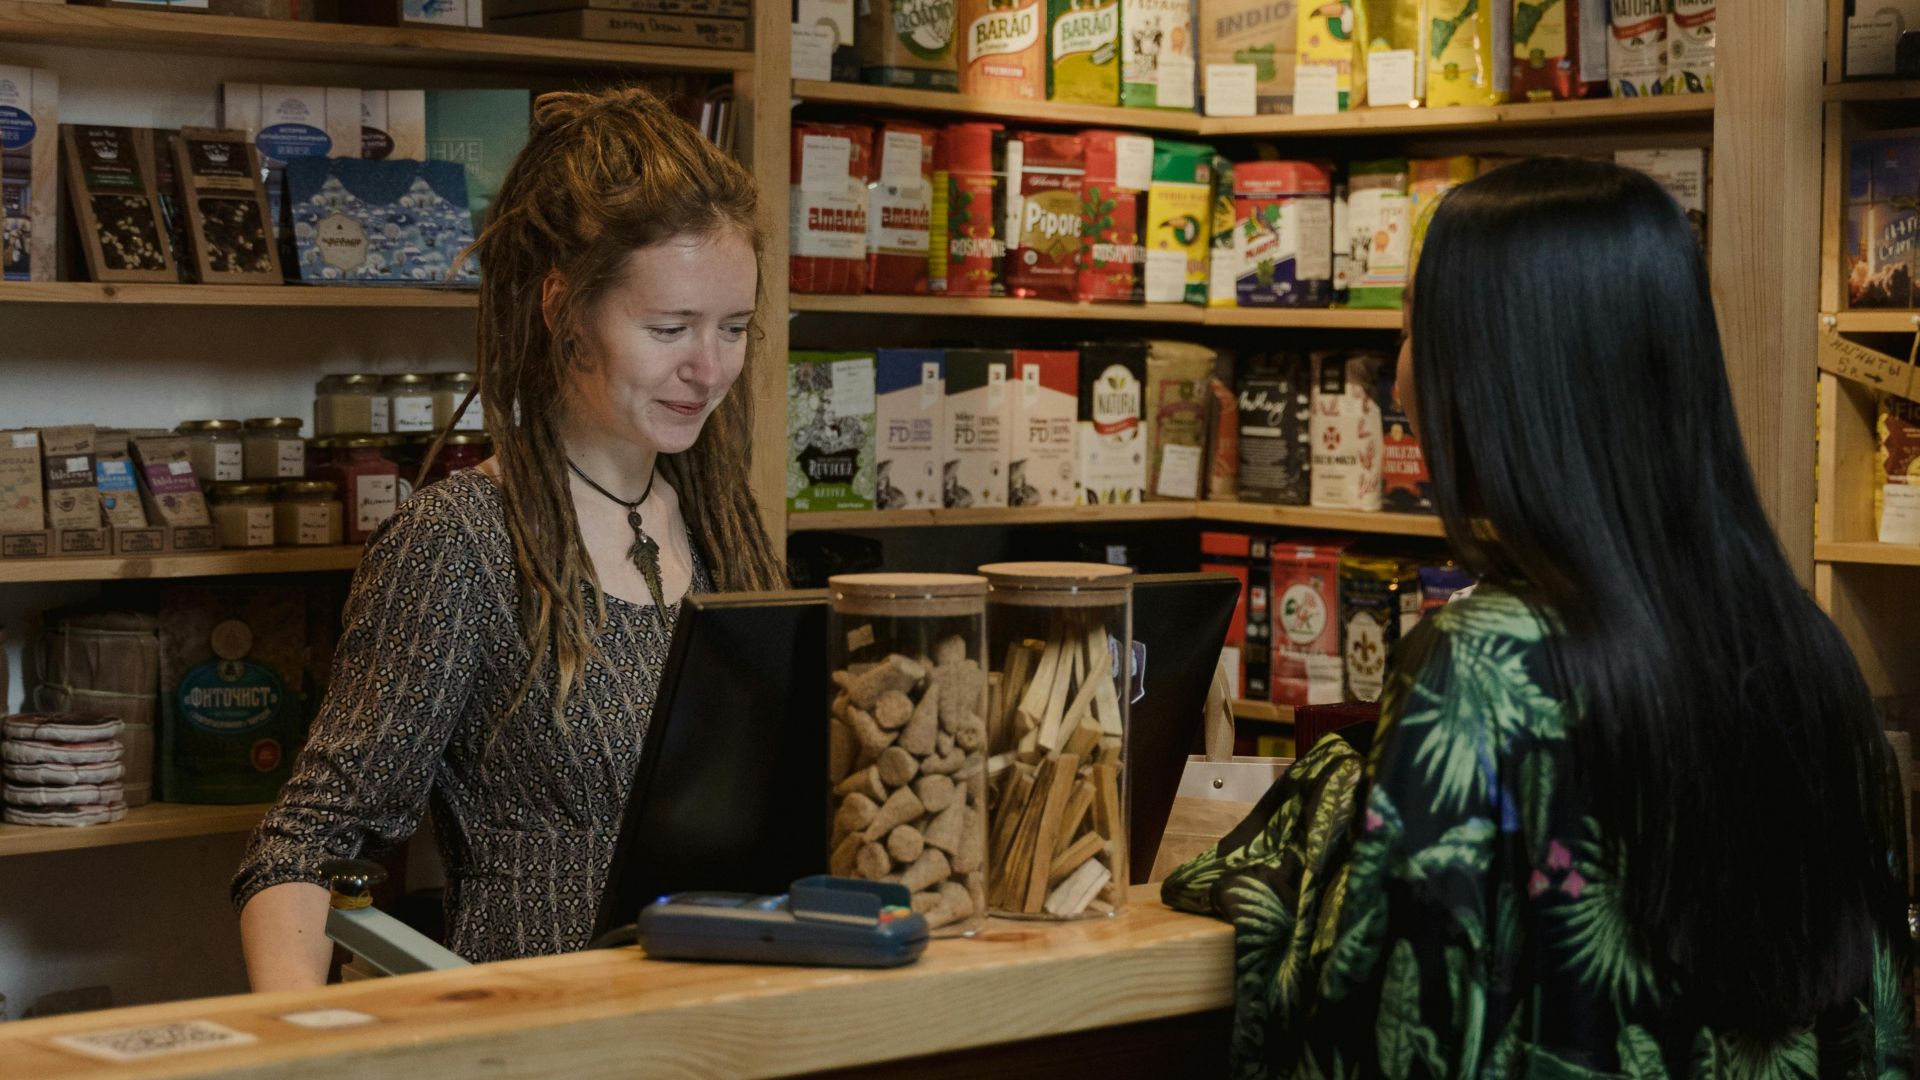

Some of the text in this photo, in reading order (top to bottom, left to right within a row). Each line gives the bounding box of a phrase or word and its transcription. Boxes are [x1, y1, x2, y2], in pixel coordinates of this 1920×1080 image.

[976, 13, 1032, 43] BARÃO
[1061, 13, 1112, 41] BARÃO
[1216, 1, 1292, 39] INDIO
[426, 141, 480, 161] НИЕ
